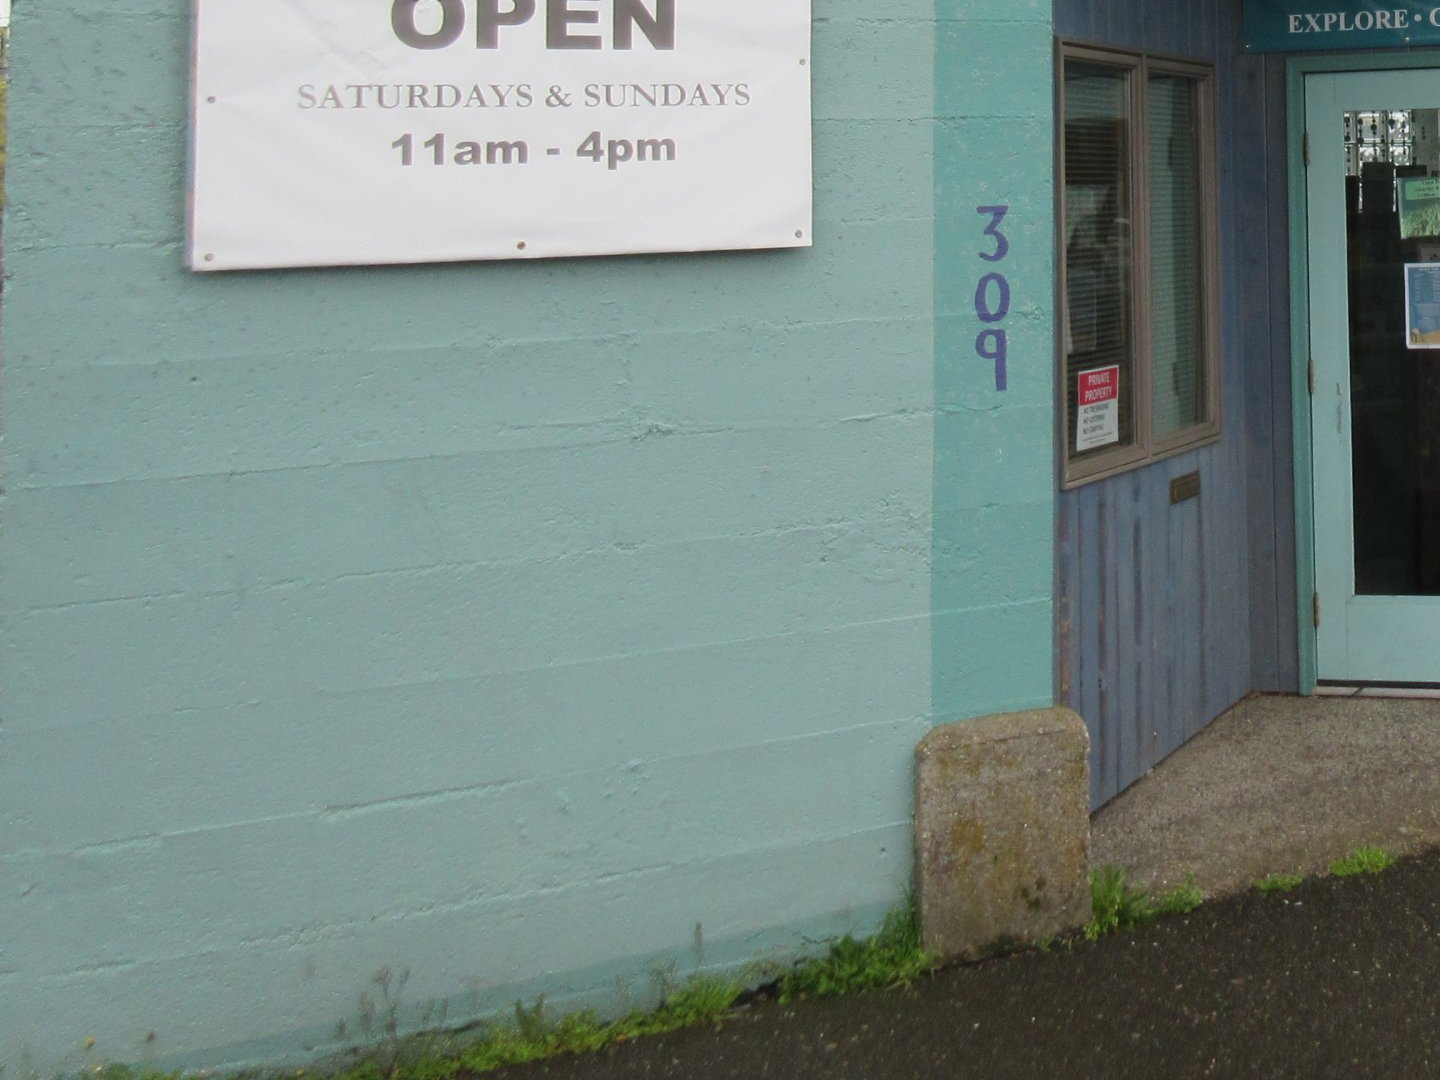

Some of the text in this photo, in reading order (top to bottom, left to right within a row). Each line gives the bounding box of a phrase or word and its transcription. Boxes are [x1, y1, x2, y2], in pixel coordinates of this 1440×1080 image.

[1288, 9, 1409, 34] EXPLORE
[298, 83, 751, 109] SATURDAYS & SUNDAYS
[391, 133, 528, 166] 11am
[576, 130, 676, 170] 4pm
[975, 205, 1010, 391] 309
[1088, 372, 1110, 386] PRIVATE
[1085, 385, 1112, 402] PROPERTY
